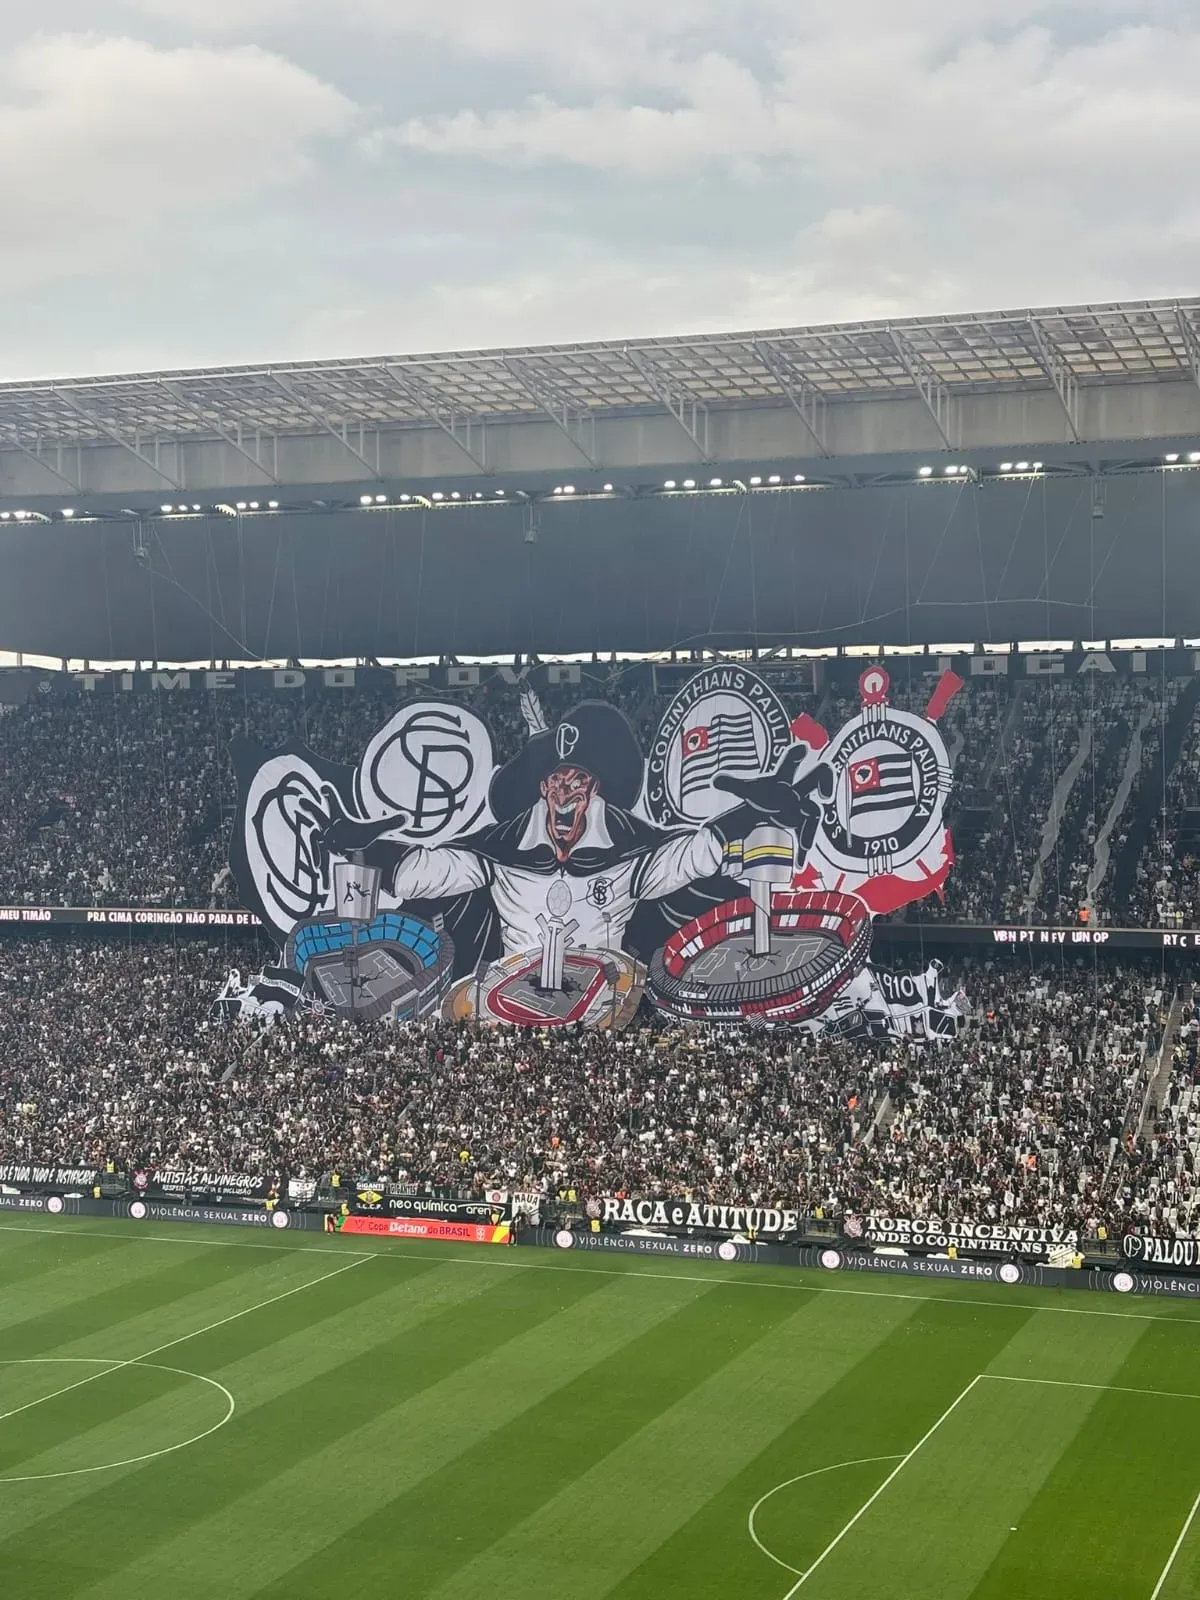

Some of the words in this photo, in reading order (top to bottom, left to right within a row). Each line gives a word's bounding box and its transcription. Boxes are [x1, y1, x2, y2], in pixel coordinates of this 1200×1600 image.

[72, 671, 236, 690] TIME
[273, 669, 355, 688] DO
[396, 664, 581, 686] POVO
[651, 671, 746, 773] CORINTHIANS
[832, 723, 911, 774] RINTHIANS
[909, 736, 937, 818] PAULISTA
[863, 836, 899, 856] 1910
[0, 910, 19, 920] MEU
[22, 909, 51, 921] TIMÃO
[87, 911, 106, 923] PRA
[108, 912, 132, 923] CIMA
[135, 911, 183, 924] CORINGÃO
[185, 911, 205, 924] NÃO
[208, 913, 234, 925] PARA
[237, 913, 249, 925] DE
[200, 1173, 264, 1188] ALVINEGROS
[19, 1199, 43, 1207] ZERO
[389, 1200, 411, 1210] neo
[414, 1200, 457, 1214] química
[466, 1205, 493, 1216] aren
[151, 1206, 200, 1218] VIOLÊNCIA
[203, 1210, 238, 1221] SEXUAL
[241, 1213, 267, 1223] ZERO
[602, 1198, 669, 1226] RAÇA
[672, 1206, 683, 1225] e
[686, 1202, 799, 1232] ATITUDE
[389, 1221, 428, 1235] Betano
[428, 1226, 438, 1235] do
[439, 1227, 471, 1238] BRASIL
[950, 1222, 1079, 1243] INCENTIVA
[578, 1234, 636, 1249] VIOLÊNCIA
[639, 1240, 678, 1252] SEXUAL
[683, 1244, 712, 1255] ZERO
[913, 1233, 924, 1245] O
[926, 1234, 1043, 1254] CORINTHIANS
[1142, 1236, 1194, 1266] FALOU
[847, 1256, 909, 1270] VIOLÊNCIA
[913, 1261, 956, 1273] SEXUAL
[961, 1265, 993, 1277] ZERO
[1141, 1280, 1200, 1292] VIOLÊNCI
